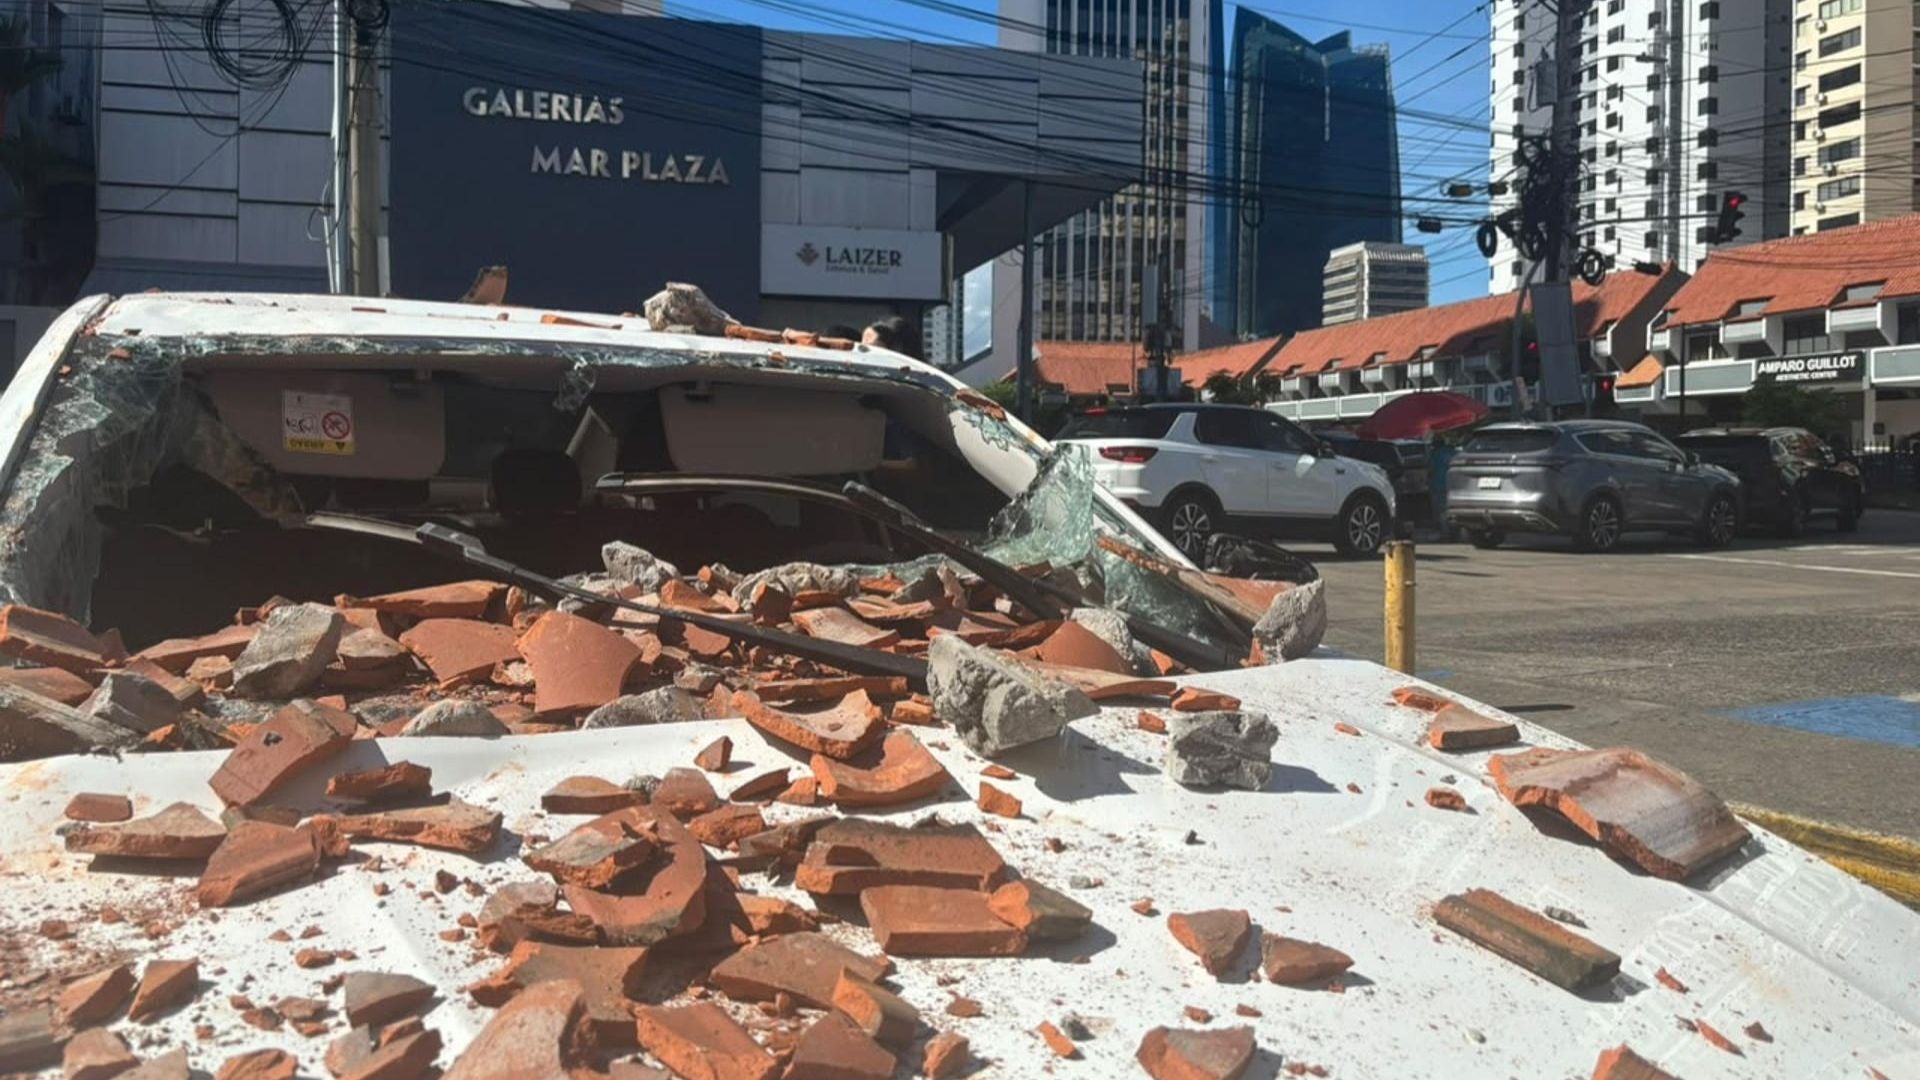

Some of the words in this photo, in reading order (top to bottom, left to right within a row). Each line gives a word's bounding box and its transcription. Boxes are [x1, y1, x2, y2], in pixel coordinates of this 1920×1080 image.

[463, 87, 625, 124] GALERIAS
[530, 145, 611, 178] MAR
[621, 150, 730, 184] PLAZA
[826, 246, 902, 267] LAIZER
[1758, 360, 1804, 374] AMPARO
[1807, 355, 1857, 370] GUILLOT
